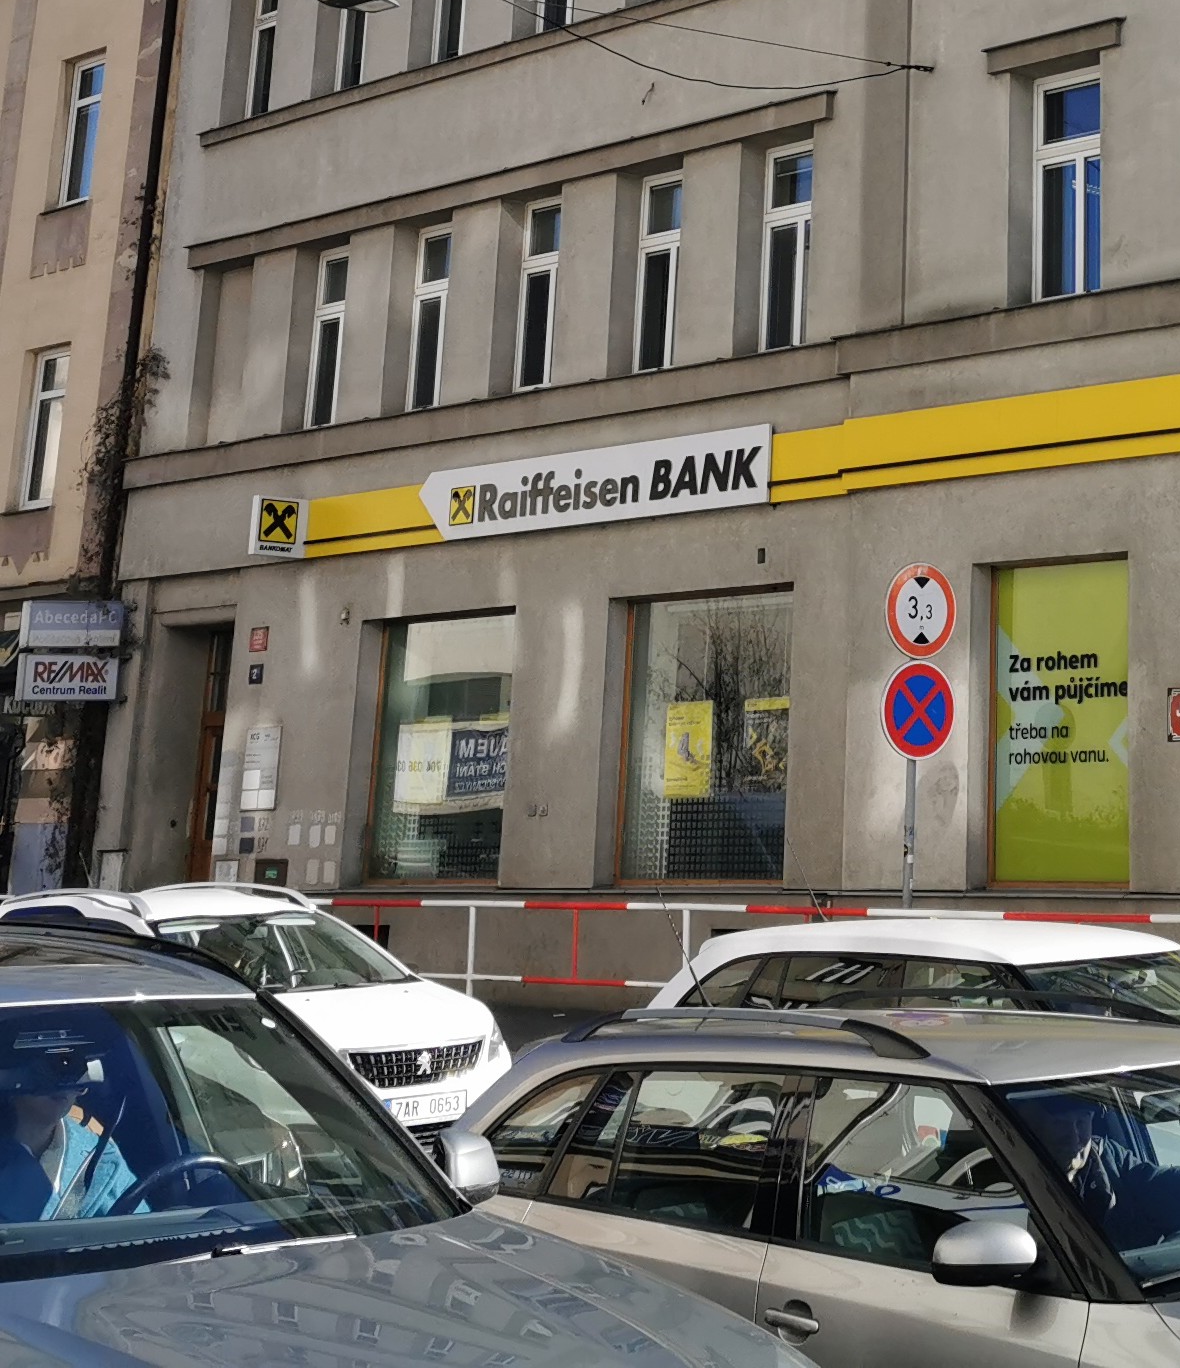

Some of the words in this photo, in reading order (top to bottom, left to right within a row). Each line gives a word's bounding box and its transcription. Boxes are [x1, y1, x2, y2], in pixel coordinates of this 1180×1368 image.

[477, 470, 639, 523] Raiffeisen
[648, 445, 762, 501] BANK
[908, 595, 933, 621] 3,3
[1009, 654, 1031, 673] Za
[1036, 650, 1098, 672] rohem
[32, 685, 76, 695] Centrum
[78, 685, 107, 695] Realit
[1008, 680, 1050, 702] vám
[1054, 676, 1128, 705] půjčíme
[1008, 723, 1047, 740] třeba
[1051, 725, 1069, 739] na
[1008, 748, 1067, 765] rohovou
[1070, 749, 1110, 763] vanu.
[396, 1100, 420, 1117] 7AR
[429, 1095, 460, 1114] 0653
